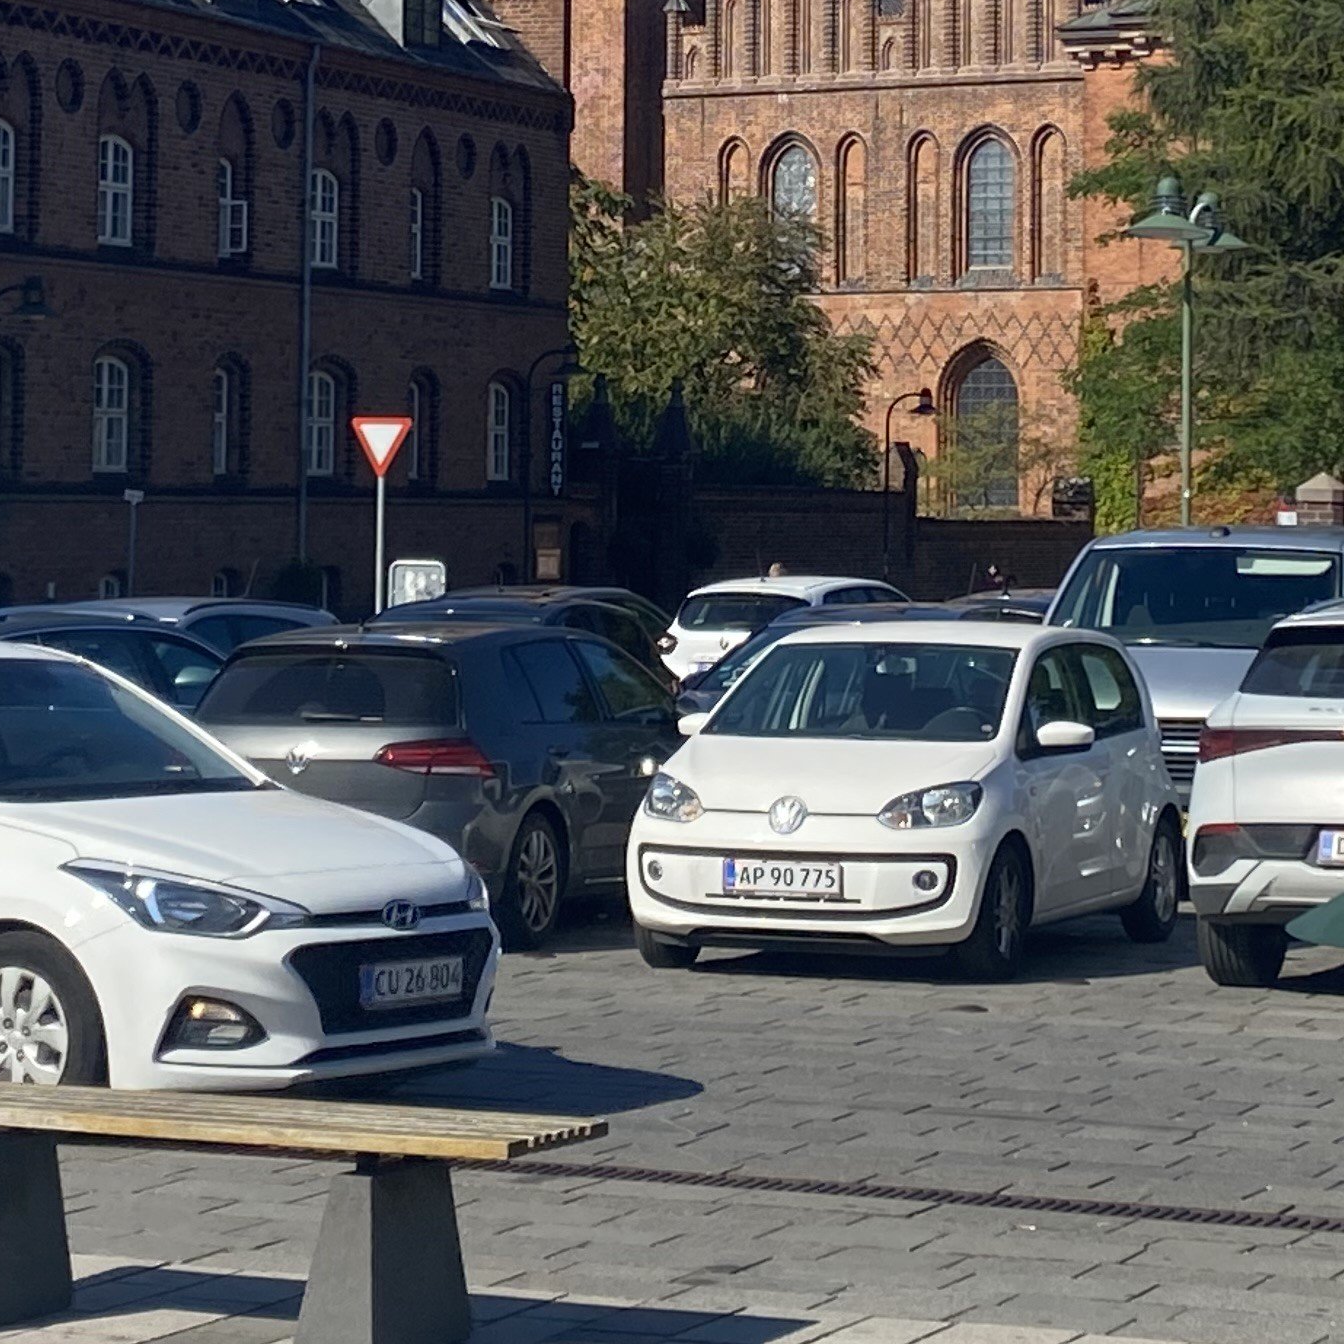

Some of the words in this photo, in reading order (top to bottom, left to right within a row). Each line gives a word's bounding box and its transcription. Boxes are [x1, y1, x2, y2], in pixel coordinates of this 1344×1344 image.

[550, 383, 563, 497] RESTAURANT
[739, 866, 765, 886] AP
[770, 866, 794, 887] 90
[799, 867, 836, 889] 775
[375, 969, 400, 996] CU
[404, 965, 425, 993] 26
[430, 962, 461, 991] 804
